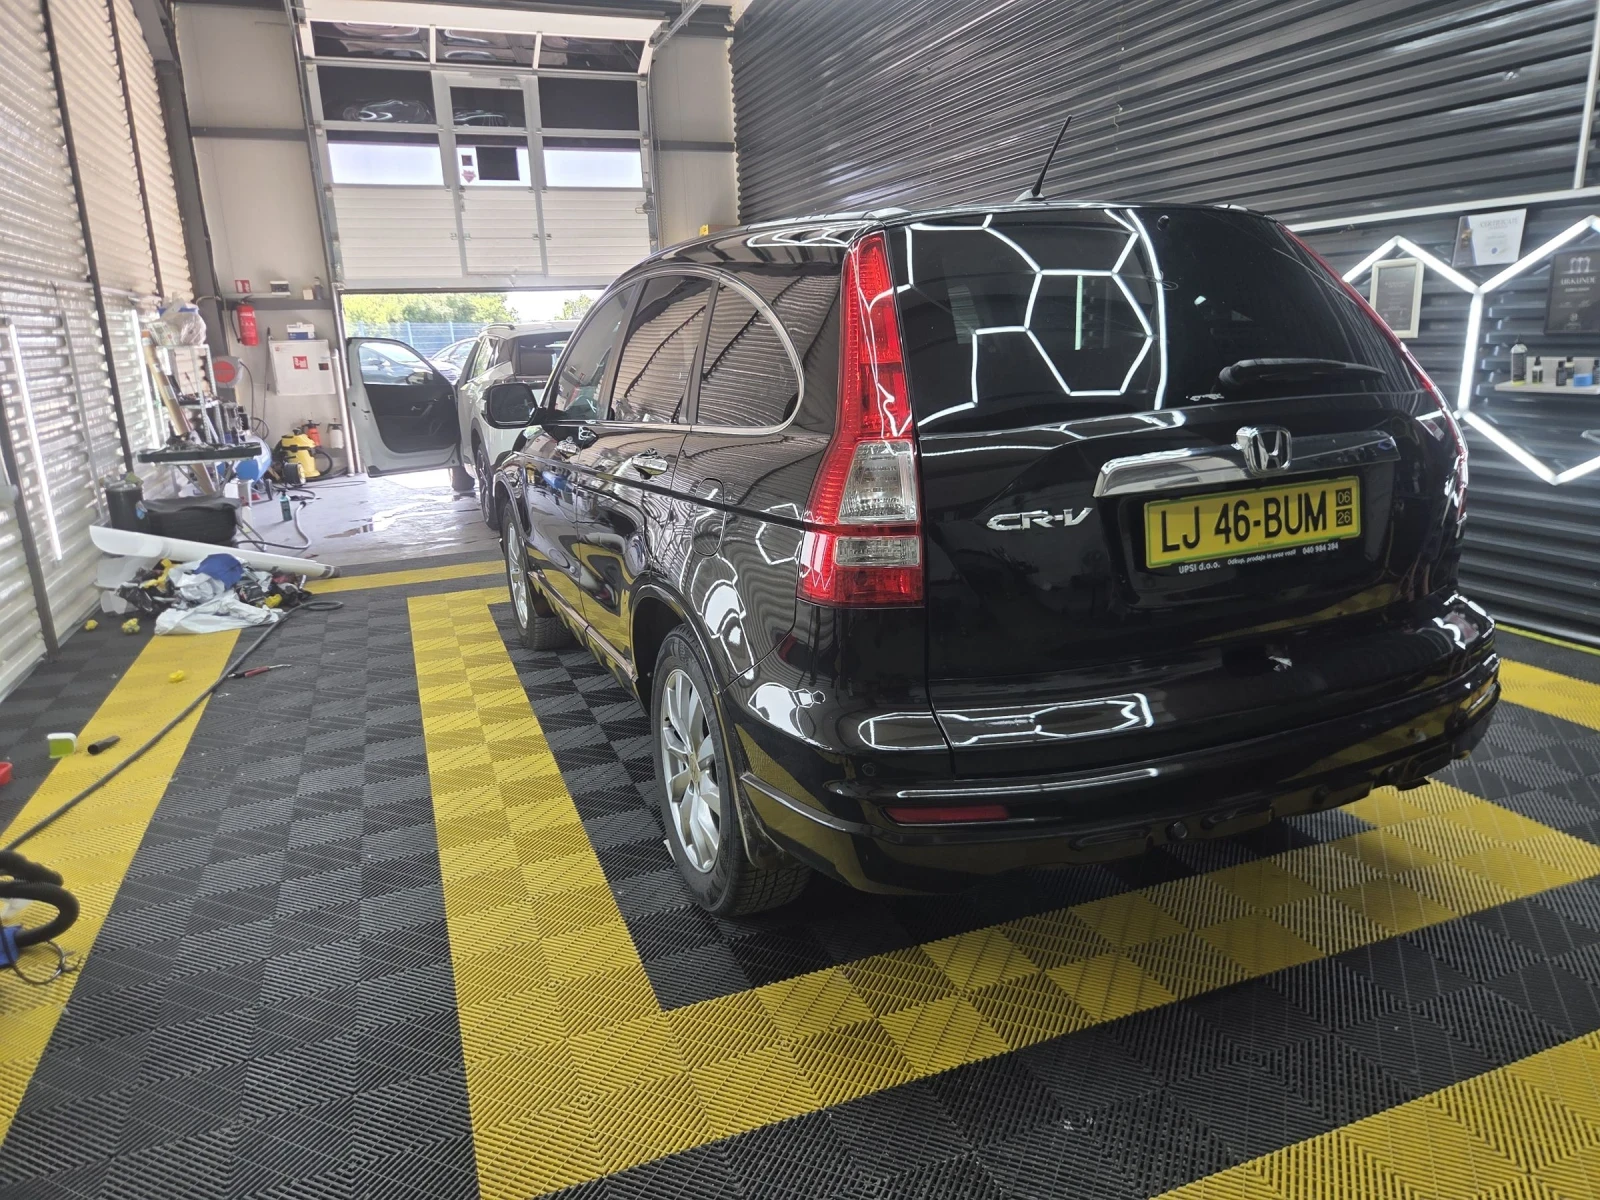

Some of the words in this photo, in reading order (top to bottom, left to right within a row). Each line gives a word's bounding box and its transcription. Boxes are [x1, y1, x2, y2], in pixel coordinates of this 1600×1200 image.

[1560, 276, 1596, 286] URKUNDE
[1337, 491, 1351, 505] 06
[986, 507, 1093, 531] CR-V
[1160, 506, 1201, 553] LJ
[1214, 490, 1327, 545] 46-BUM
[1337, 511, 1351, 525] 26
[1178, 563, 1196, 574] UPSI
[1198, 562, 1221, 571] d.o.o.
[1246, 553, 1265, 564] prodaja
